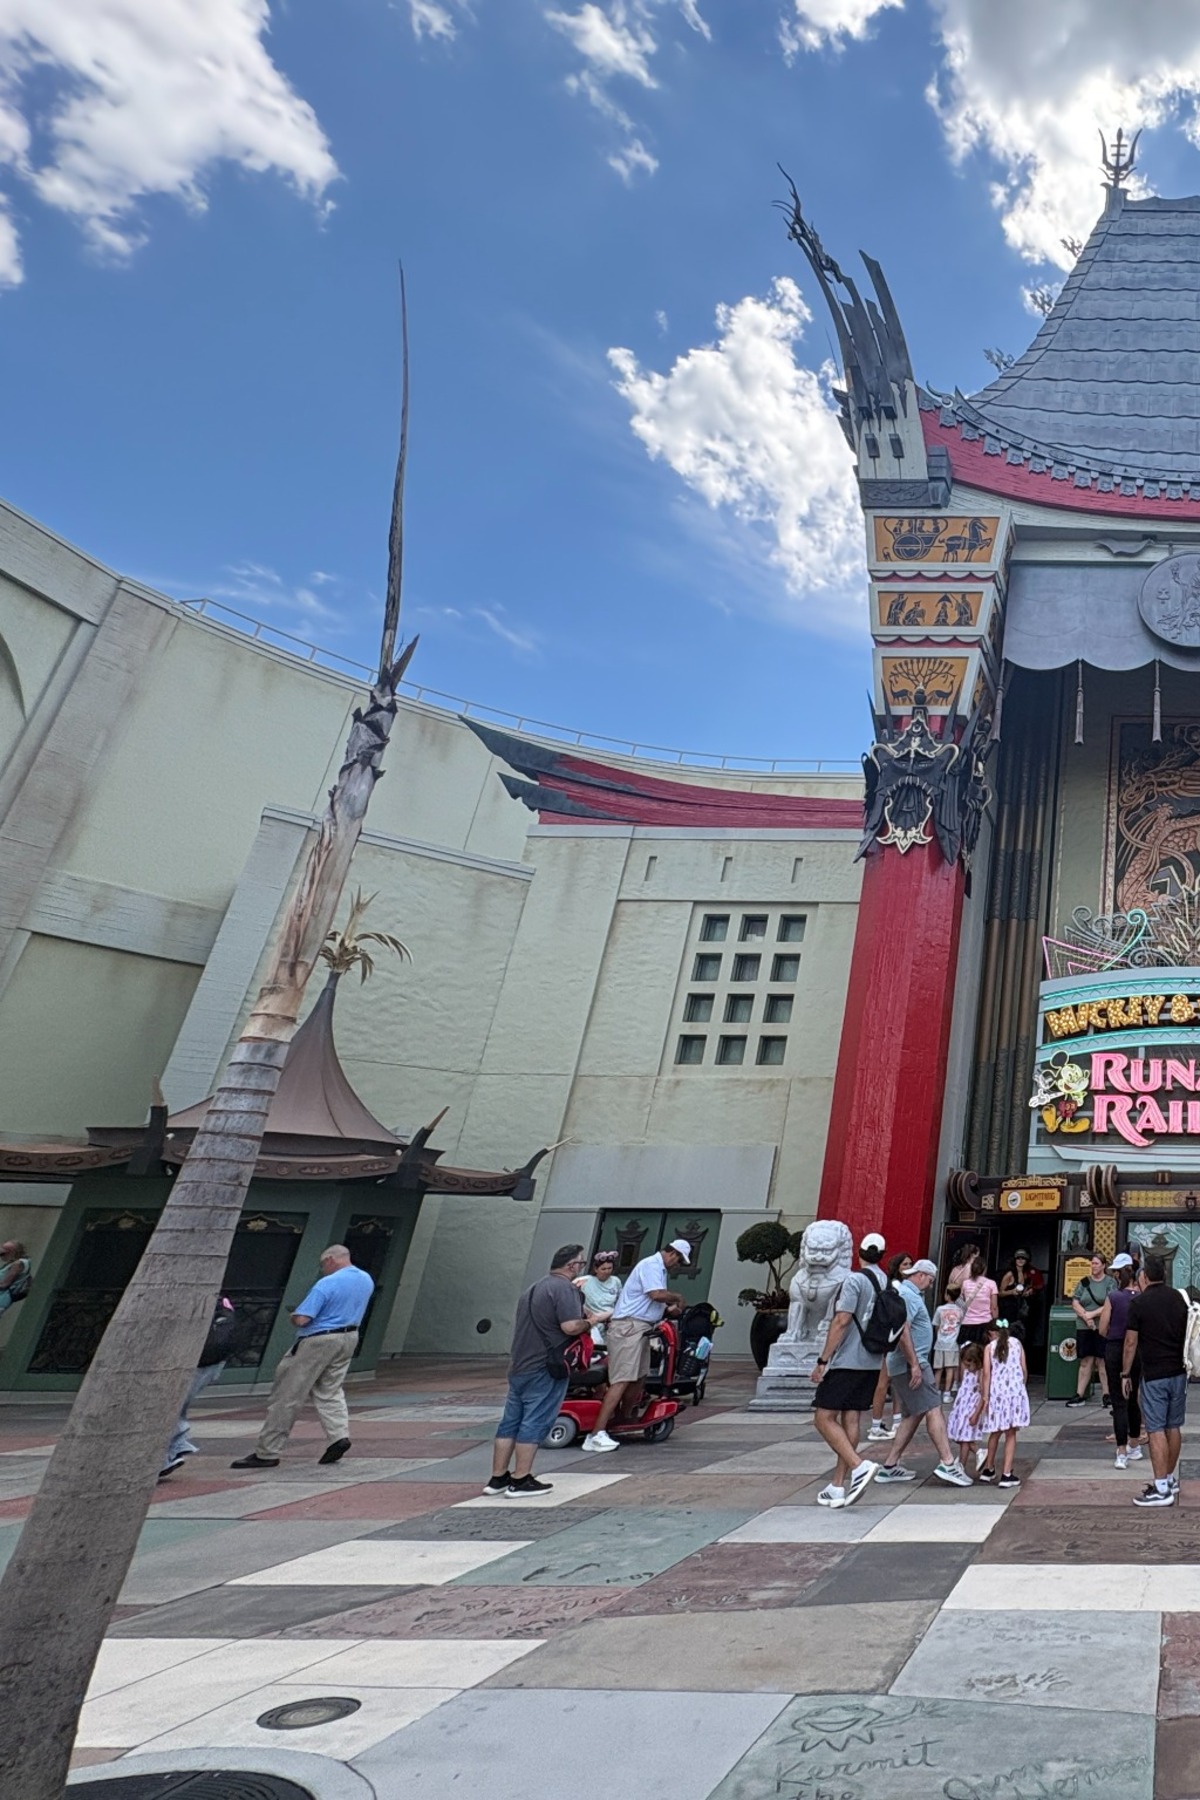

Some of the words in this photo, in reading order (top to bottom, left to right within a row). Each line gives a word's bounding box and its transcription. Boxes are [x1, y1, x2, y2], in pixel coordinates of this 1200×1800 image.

[1045, 993, 1165, 1038] MICKEY
[1171, 993, 1195, 1023] &
[776, 1736, 944, 1793] Kermit
